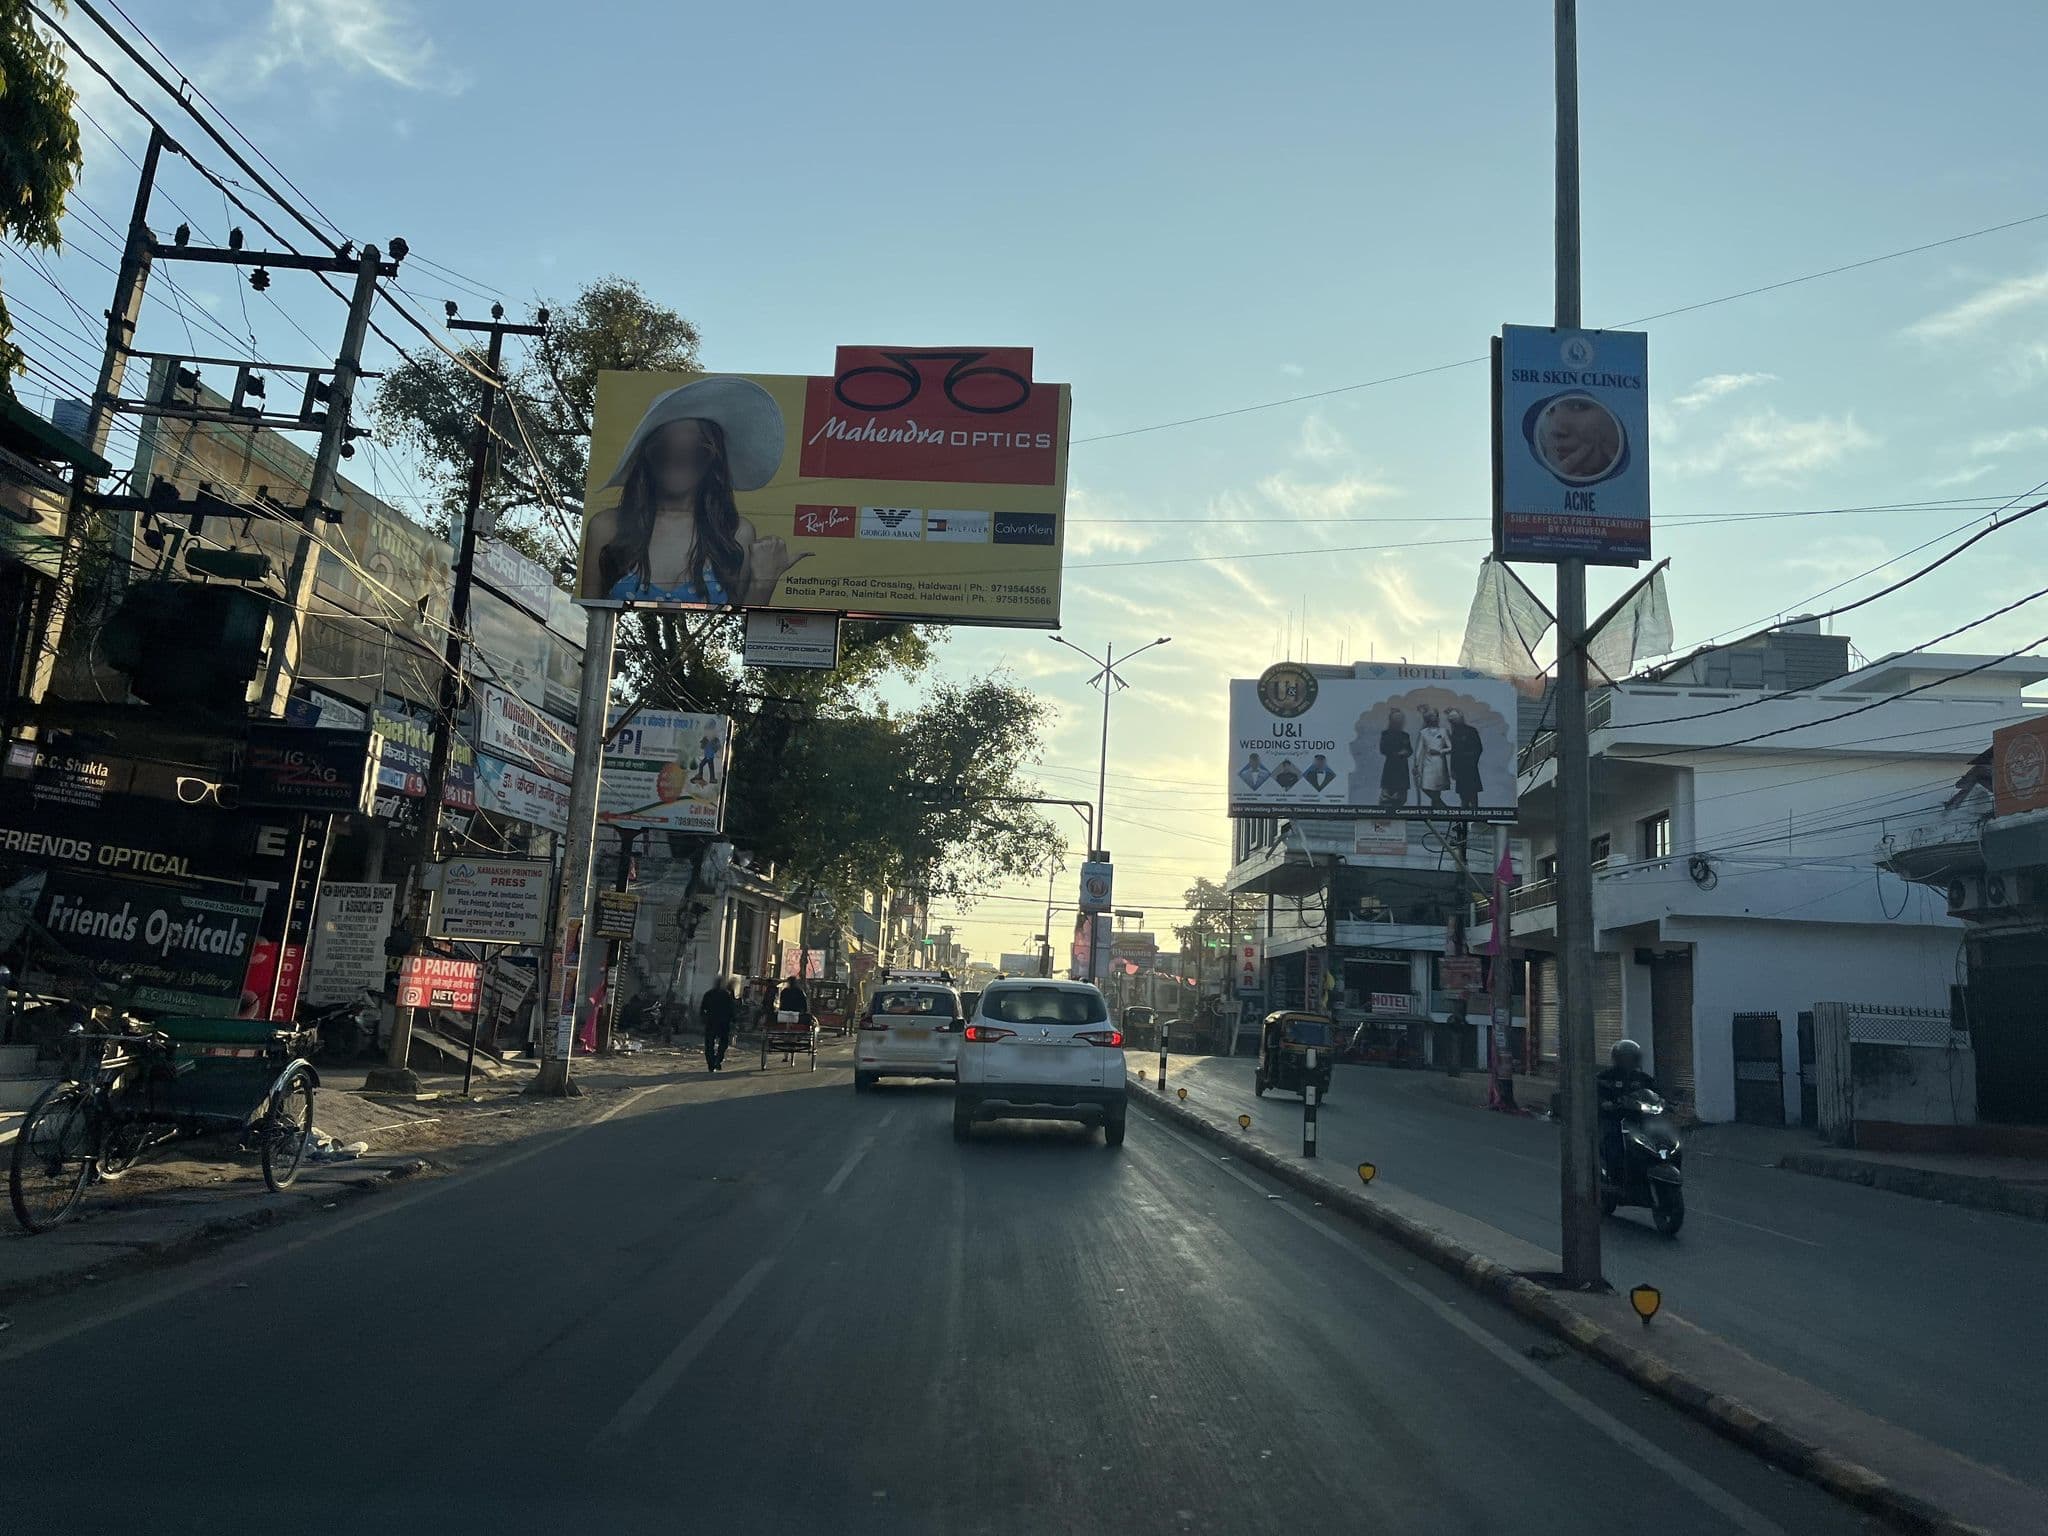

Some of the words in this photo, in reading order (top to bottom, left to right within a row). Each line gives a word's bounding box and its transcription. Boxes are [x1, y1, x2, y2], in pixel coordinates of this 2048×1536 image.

[1511, 368, 1540, 383] SBR
[1543, 370, 1577, 385] SKIN
[1581, 372, 1641, 390] CLINICS
[809, 416, 946, 447] Mahendra
[950, 431, 1051, 449] OPTICS
[1564, 490, 1596, 512] ACNE
[799, 507, 850, 534] Ray-Ban
[1571, 517, 1594, 527] FREE
[1595, 518, 1644, 529] TREATMENT
[860, 528, 890, 537] GIORGIO
[893, 530, 921, 538] ARMANI
[947, 526, 988, 534] HILFIGER
[995, 522, 1027, 535] Calvin
[1027, 523, 1053, 536] Klein
[1548, 525, 1559, 534] BY
[1561, 526, 1608, 537] AYURVEDA
[842, 578, 868, 588] Road
[870, 579, 916, 591] Crossing,
[785, 586, 817, 596] Bhotia
[851, 589, 888, 599] Nainital
[1398, 666, 1447, 680] HOTEL
[1272, 722, 1303, 738] U&I
[1239, 739, 1291, 751] WEDDING
[1294, 740, 1336, 751] STUDIO
[64, 757, 109, 777] Shukla
[97, 844, 193, 878] OPTICAL
[512, 869, 543, 878] PRINTING
[490, 877, 526, 888] PRESS
[473, 909, 493, 918] Printing
[46, 894, 139, 942] Friends
[144, 908, 248, 958] Opticals
[401, 957, 422, 974] NO
[424, 959, 484, 980] PARKING
[1243, 947, 1254, 986] BAR
[431, 989, 477, 1004] NETCOM
[1371, 995, 1409, 1008] HOTEL
